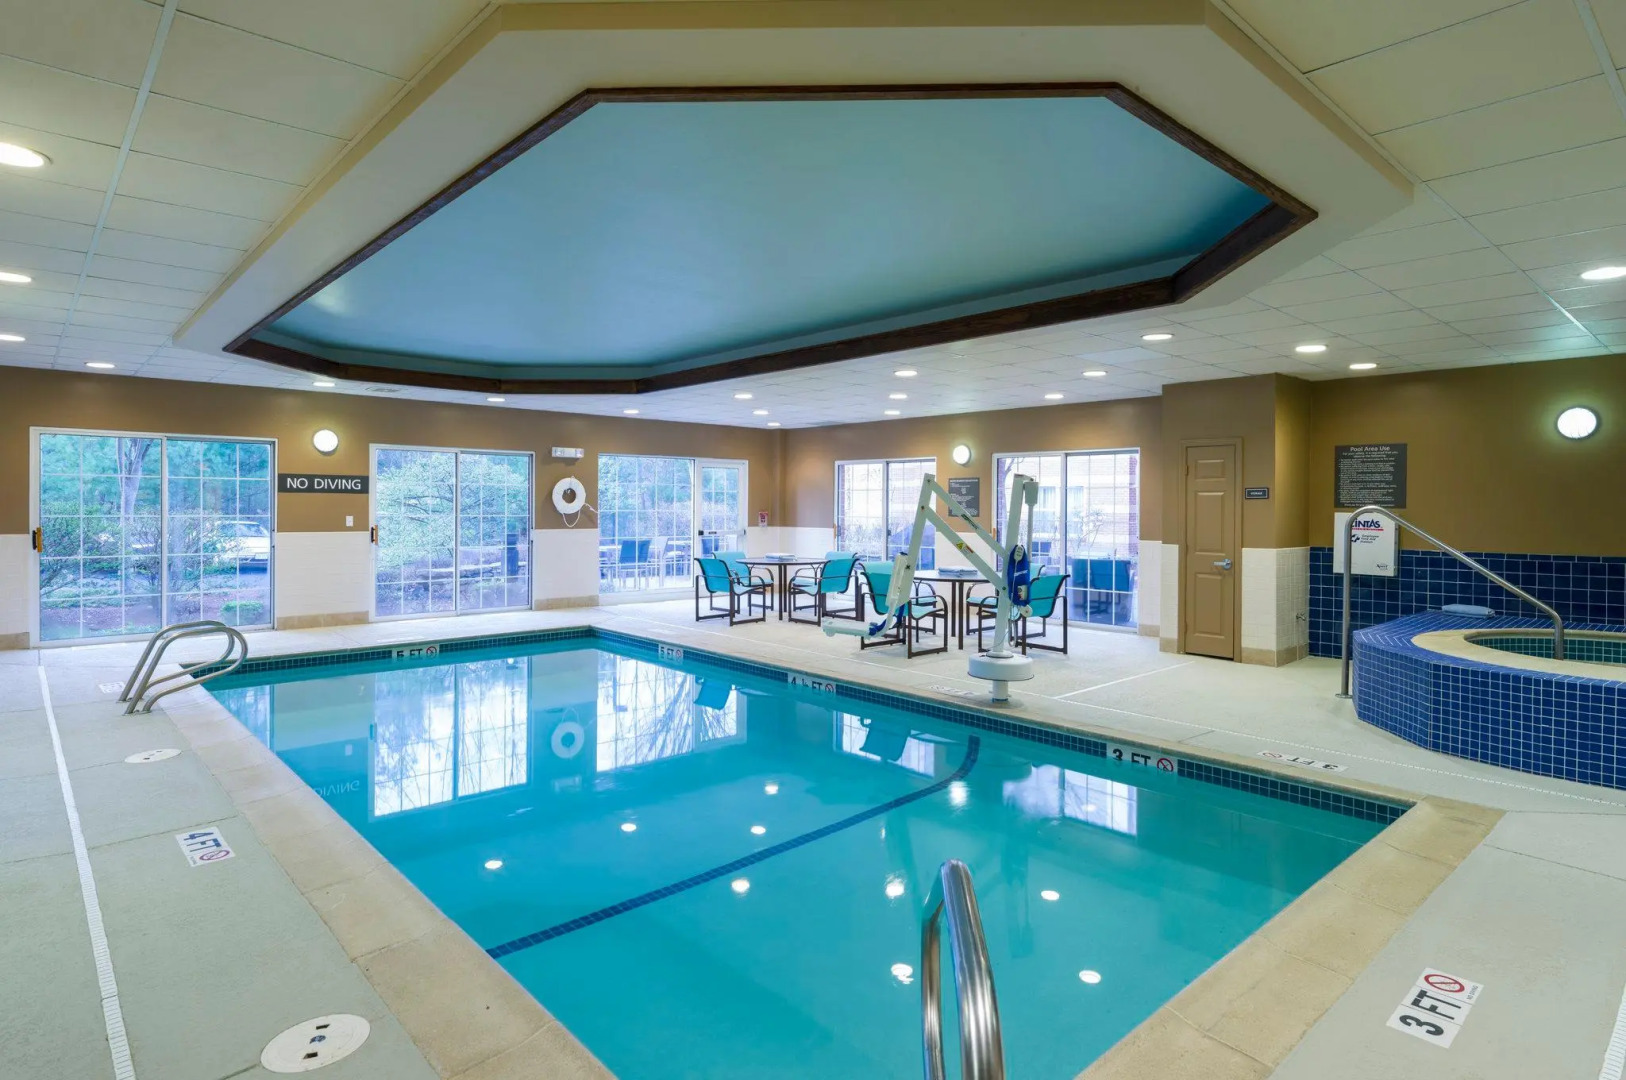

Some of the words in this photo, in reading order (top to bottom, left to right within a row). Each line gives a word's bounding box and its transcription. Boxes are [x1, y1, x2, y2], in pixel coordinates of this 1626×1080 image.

[287, 477, 308, 489] NO
[314, 478, 361, 490] DIVING
[1352, 518, 1380, 528] INTAS
[1112, 748, 1123, 761] 3
[1131, 752, 1151, 766] FT
